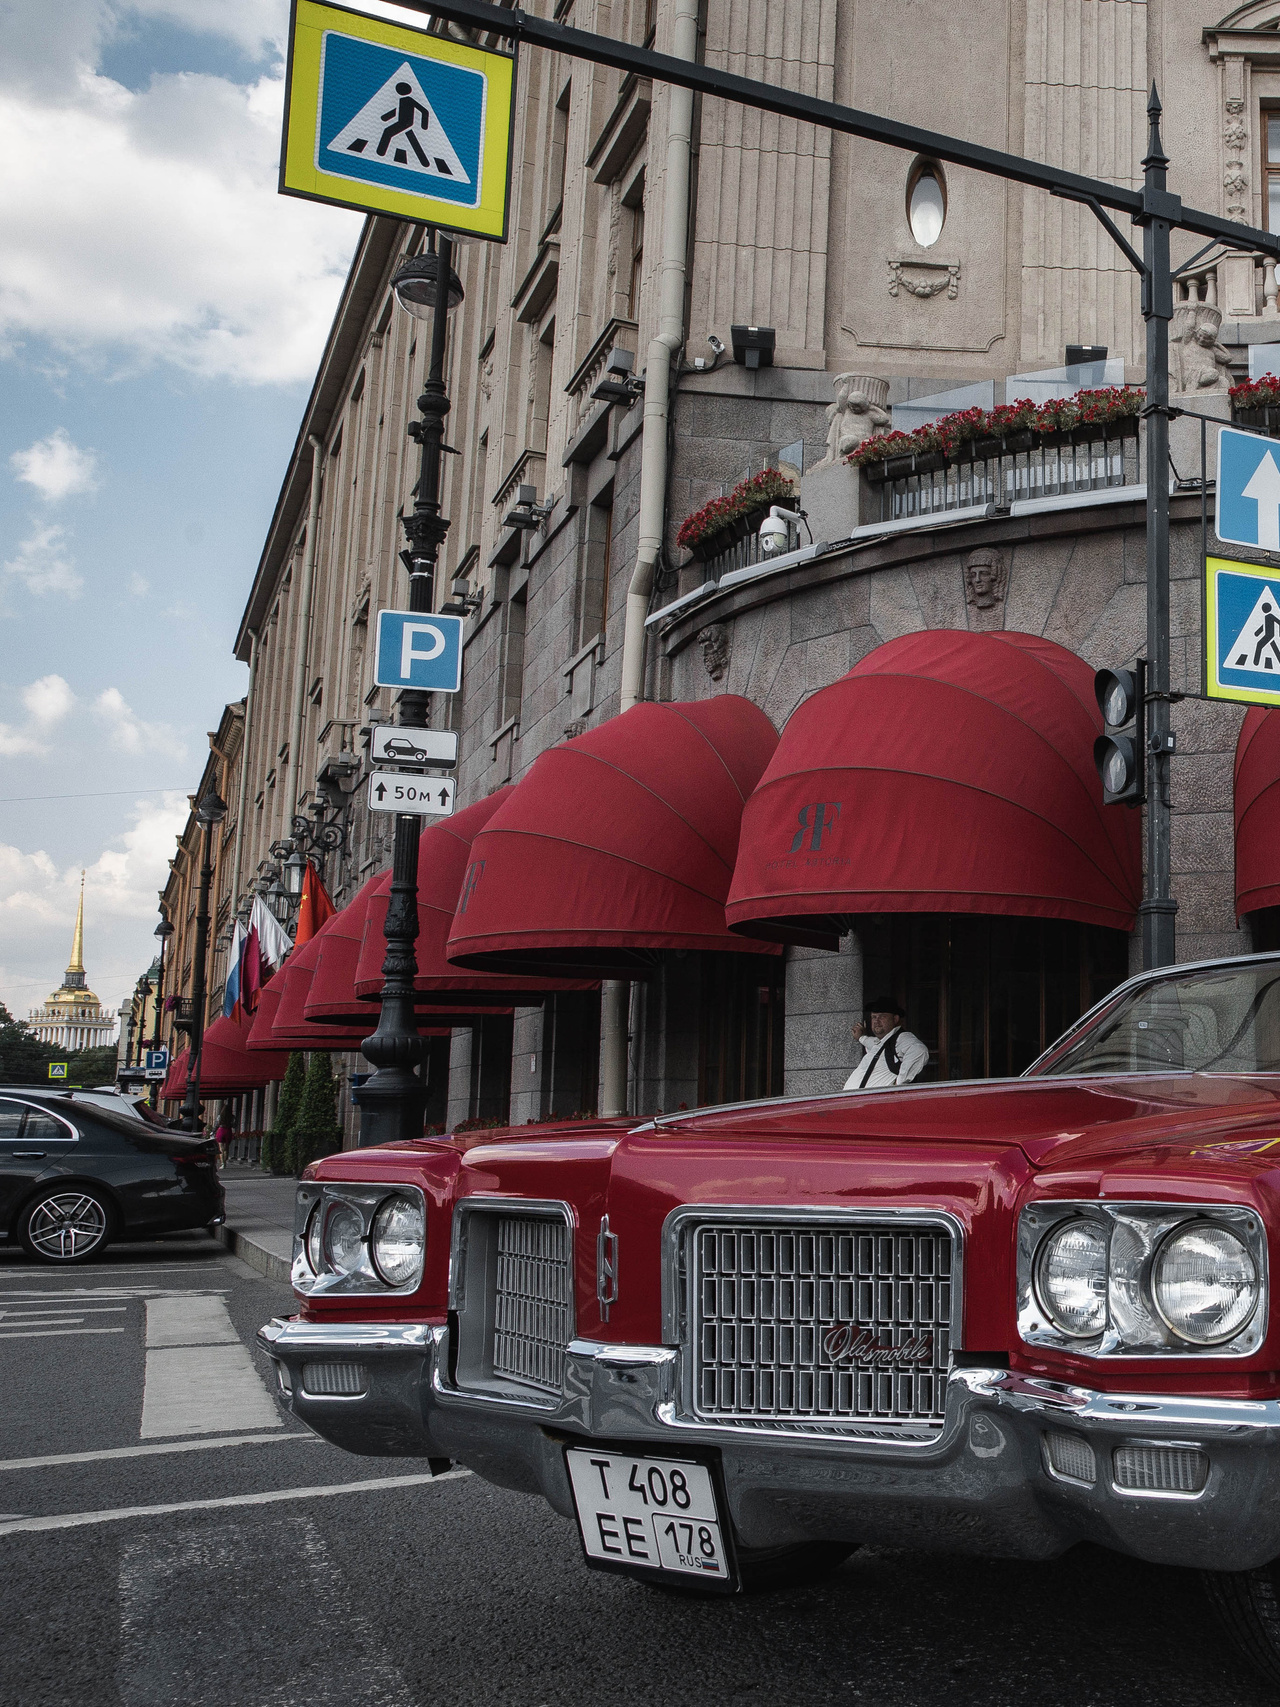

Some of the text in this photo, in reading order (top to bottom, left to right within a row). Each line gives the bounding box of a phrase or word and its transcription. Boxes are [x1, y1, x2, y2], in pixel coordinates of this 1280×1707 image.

[400, 622, 446, 679] P
[765, 857, 852, 870] HOTEL ASTORIA
[152, 1053, 164, 1067] P
[823, 1326, 931, 1362] Oldsmobile
[590, 1458, 691, 1509] T 408
[596, 1512, 715, 1559] EE 178
[679, 1554, 702, 1568] RUS
